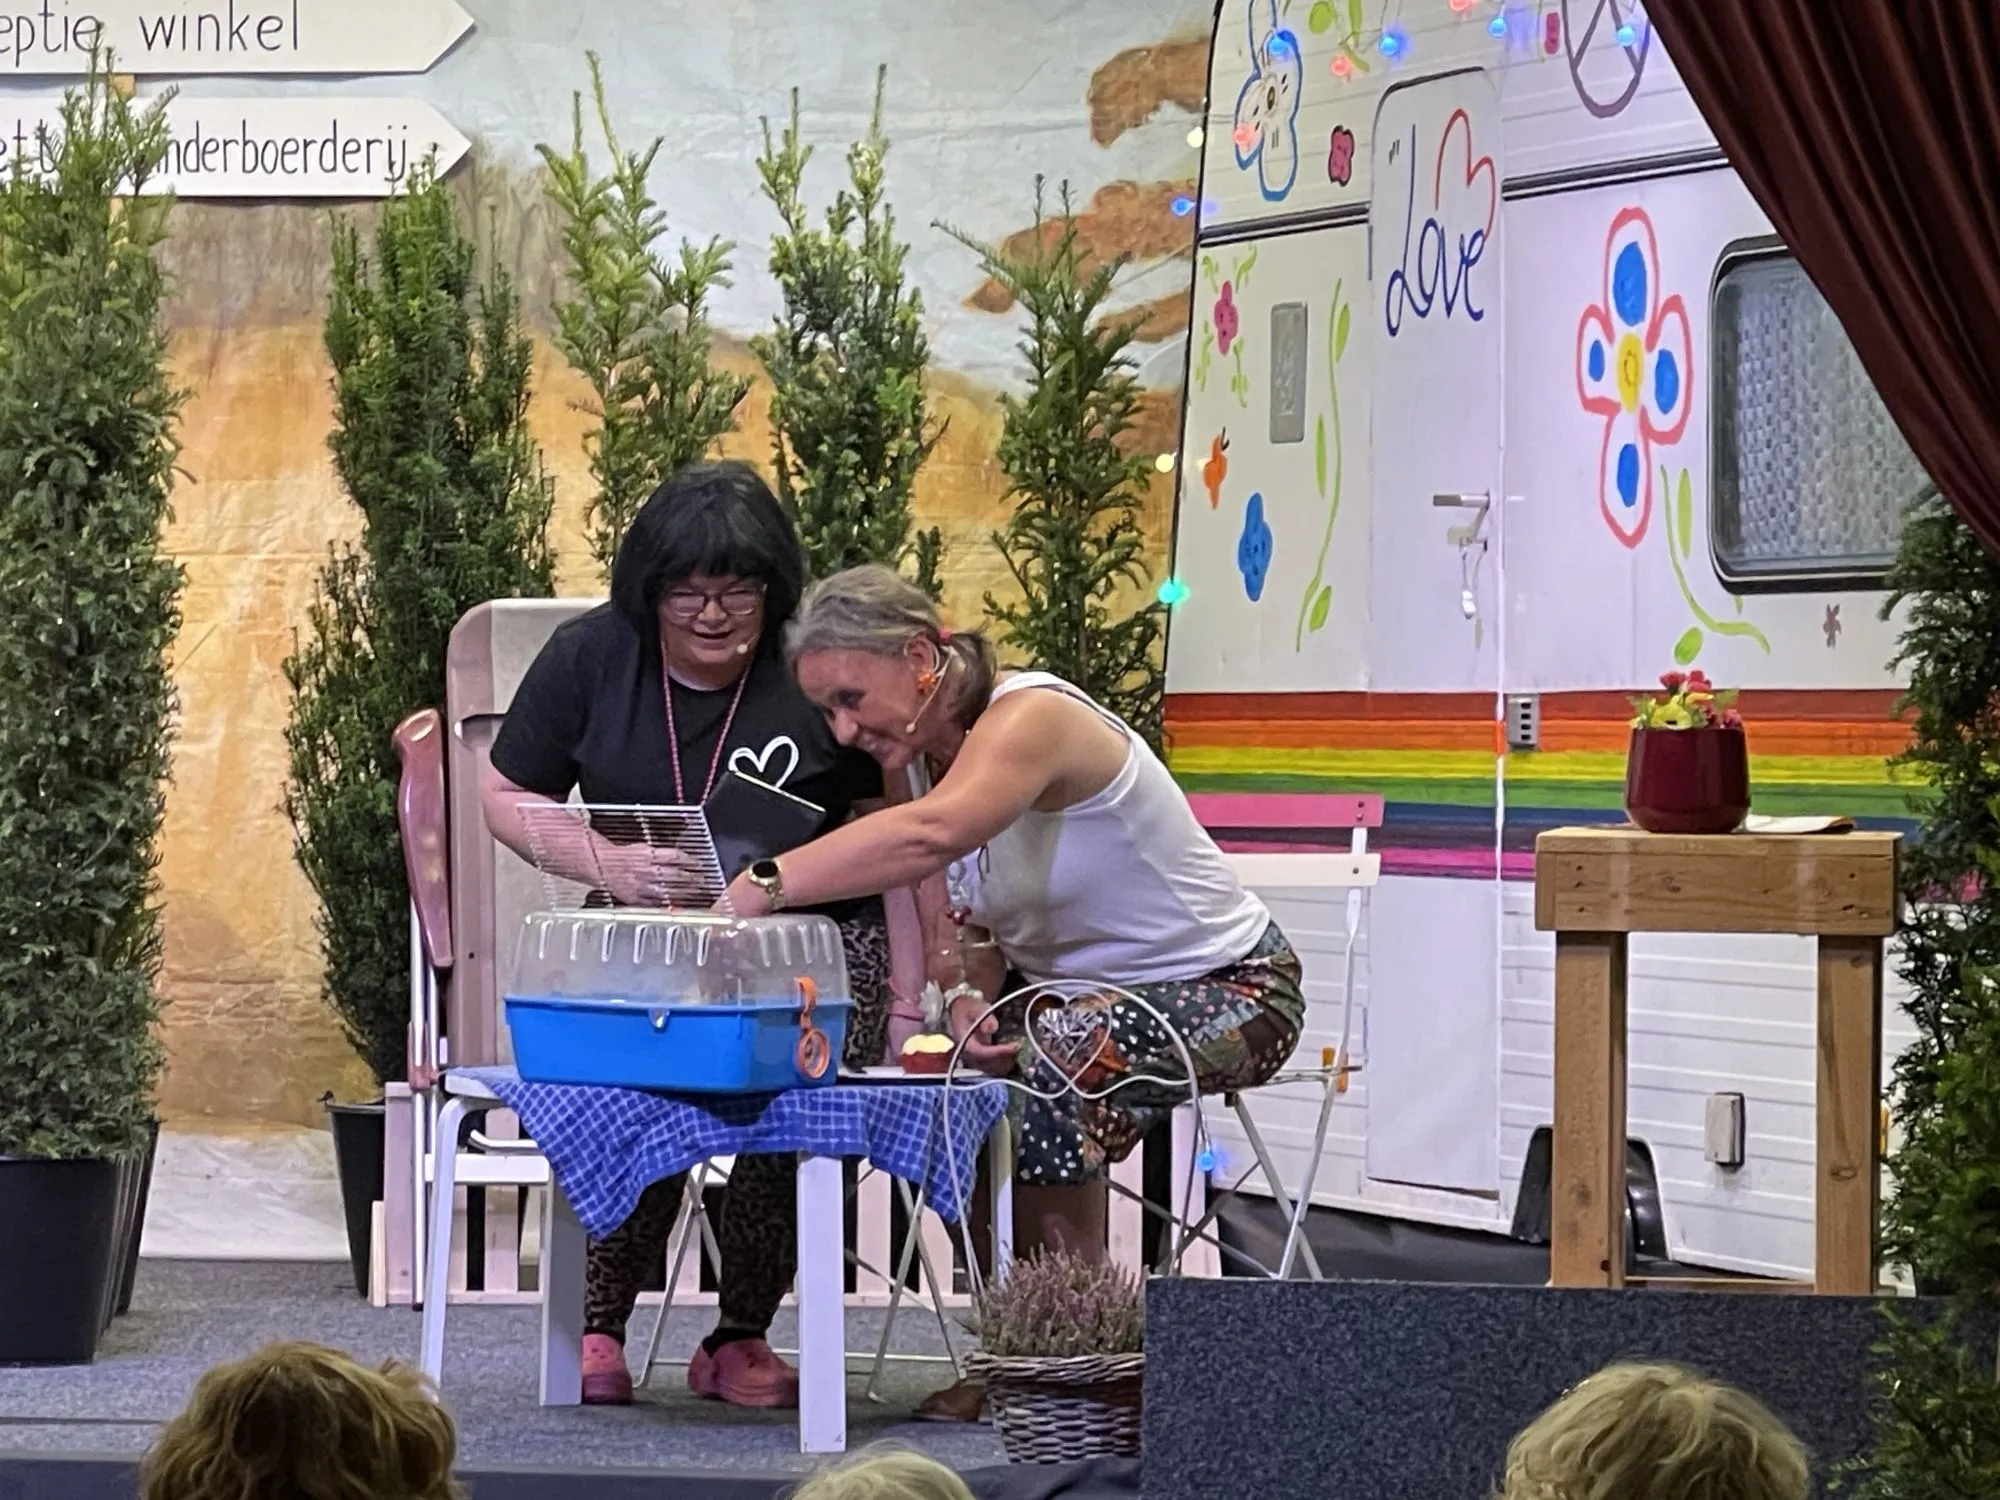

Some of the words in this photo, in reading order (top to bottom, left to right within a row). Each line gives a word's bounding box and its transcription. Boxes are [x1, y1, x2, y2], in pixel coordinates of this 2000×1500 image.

[139, 0, 299, 53] winkel
[156, 118, 408, 183] nderboerderij
[1386, 124, 1485, 337] Love
